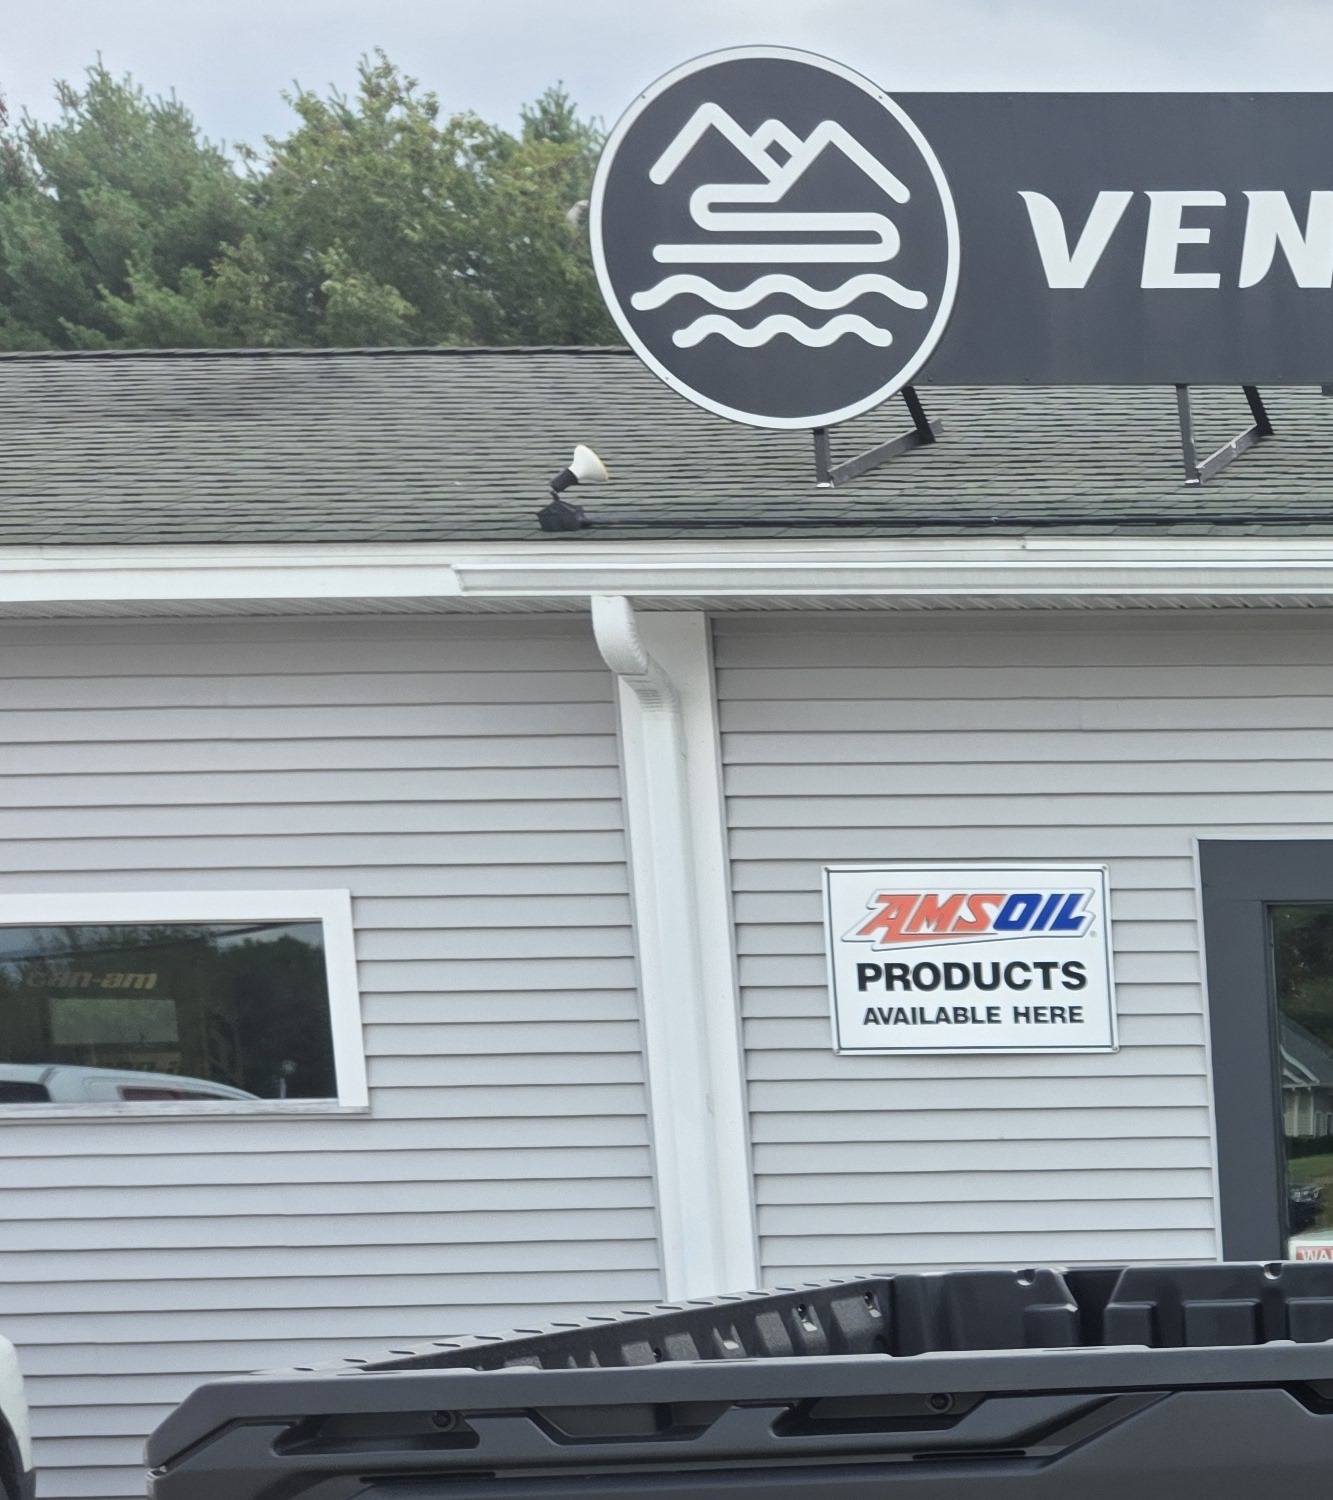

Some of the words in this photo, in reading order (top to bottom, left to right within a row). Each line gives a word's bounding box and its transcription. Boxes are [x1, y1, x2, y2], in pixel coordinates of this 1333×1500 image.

[856, 893, 1087, 944] AMSOIL
[857, 961, 1087, 991] PRODUCTS
[863, 1006, 1001, 1025] AVAILABLE
[1013, 1006, 1084, 1024] HERE
